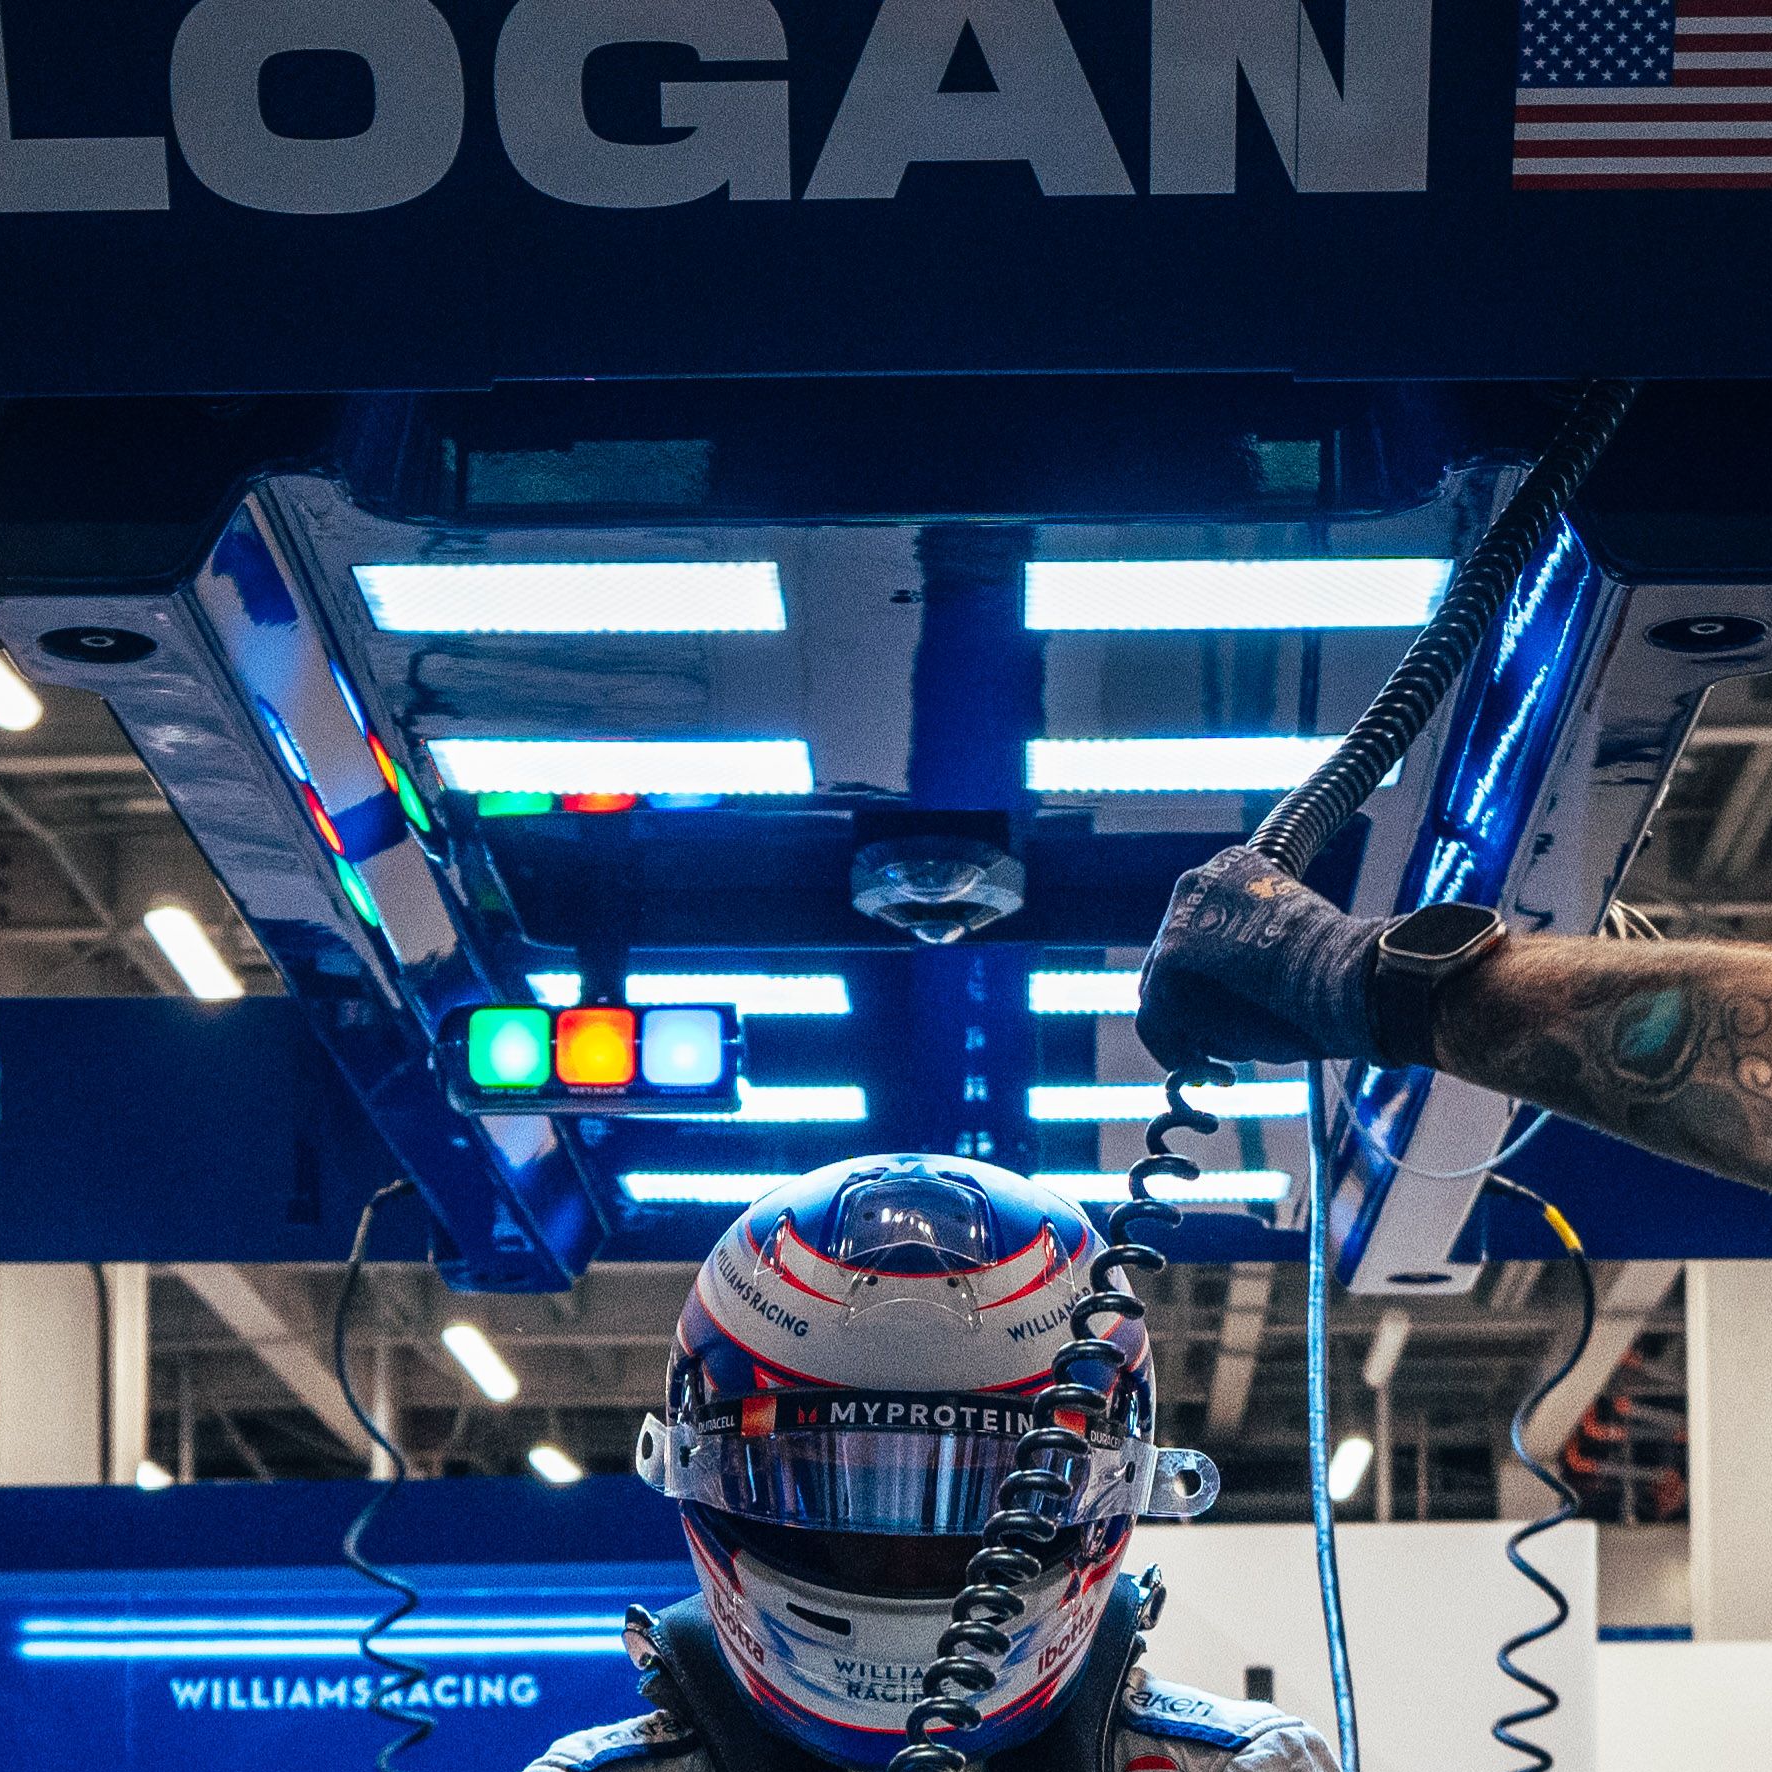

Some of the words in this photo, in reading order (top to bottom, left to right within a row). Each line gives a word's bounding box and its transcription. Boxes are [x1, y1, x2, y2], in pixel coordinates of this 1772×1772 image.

[830, 1401, 1035, 1440] MYPROTEIN
[1037, 1604, 1094, 1675] ibotta
[833, 1657, 926, 1681] WILLIA
[1130, 1689, 1215, 1718] aken
